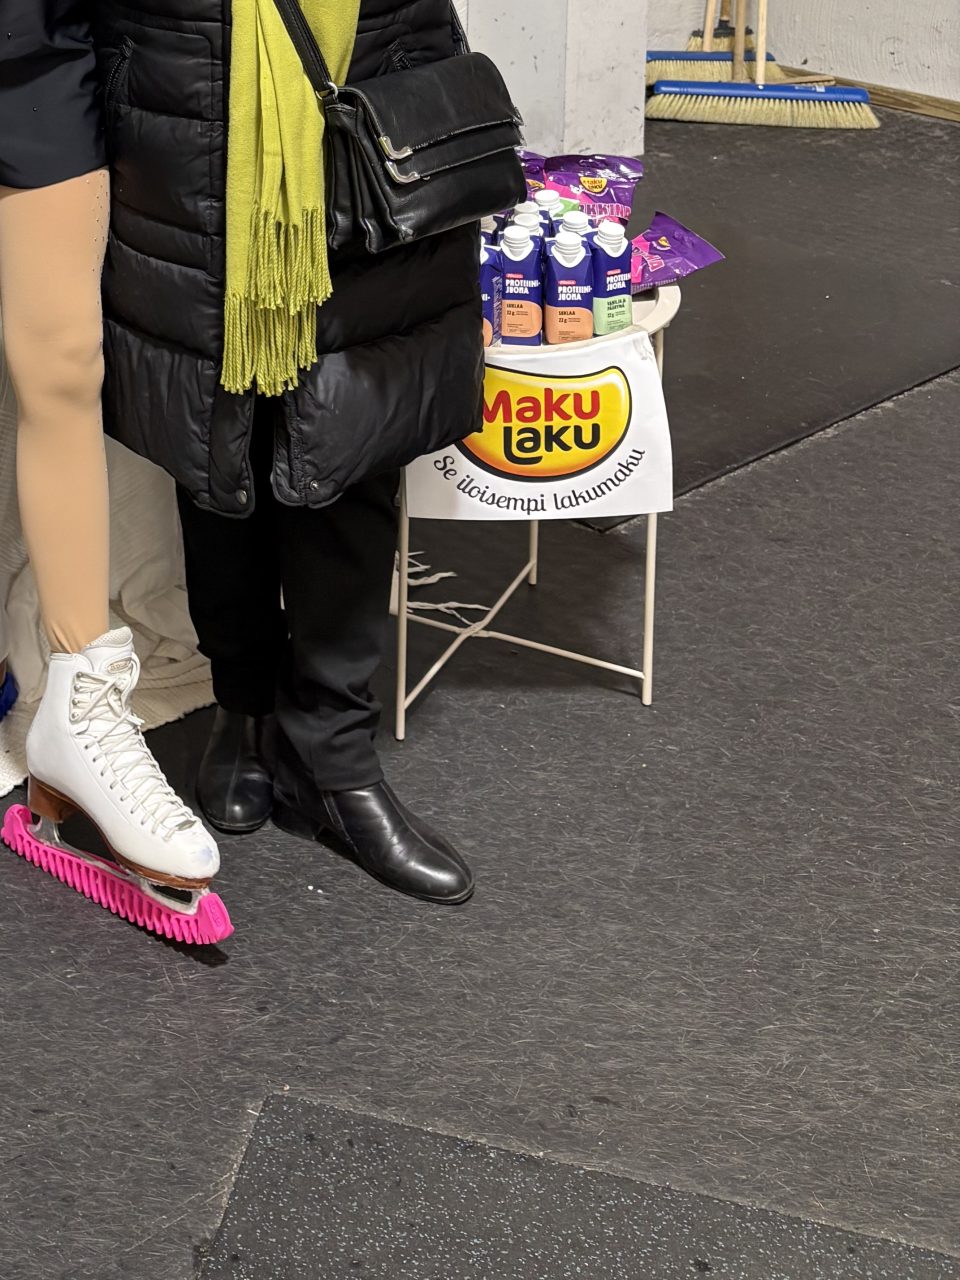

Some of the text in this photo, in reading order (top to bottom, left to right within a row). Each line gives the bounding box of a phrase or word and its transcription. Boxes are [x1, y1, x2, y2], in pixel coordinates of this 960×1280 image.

[482, 387, 601, 424] Maku
[433, 448, 646, 516] Se iloisempi lakumaku
